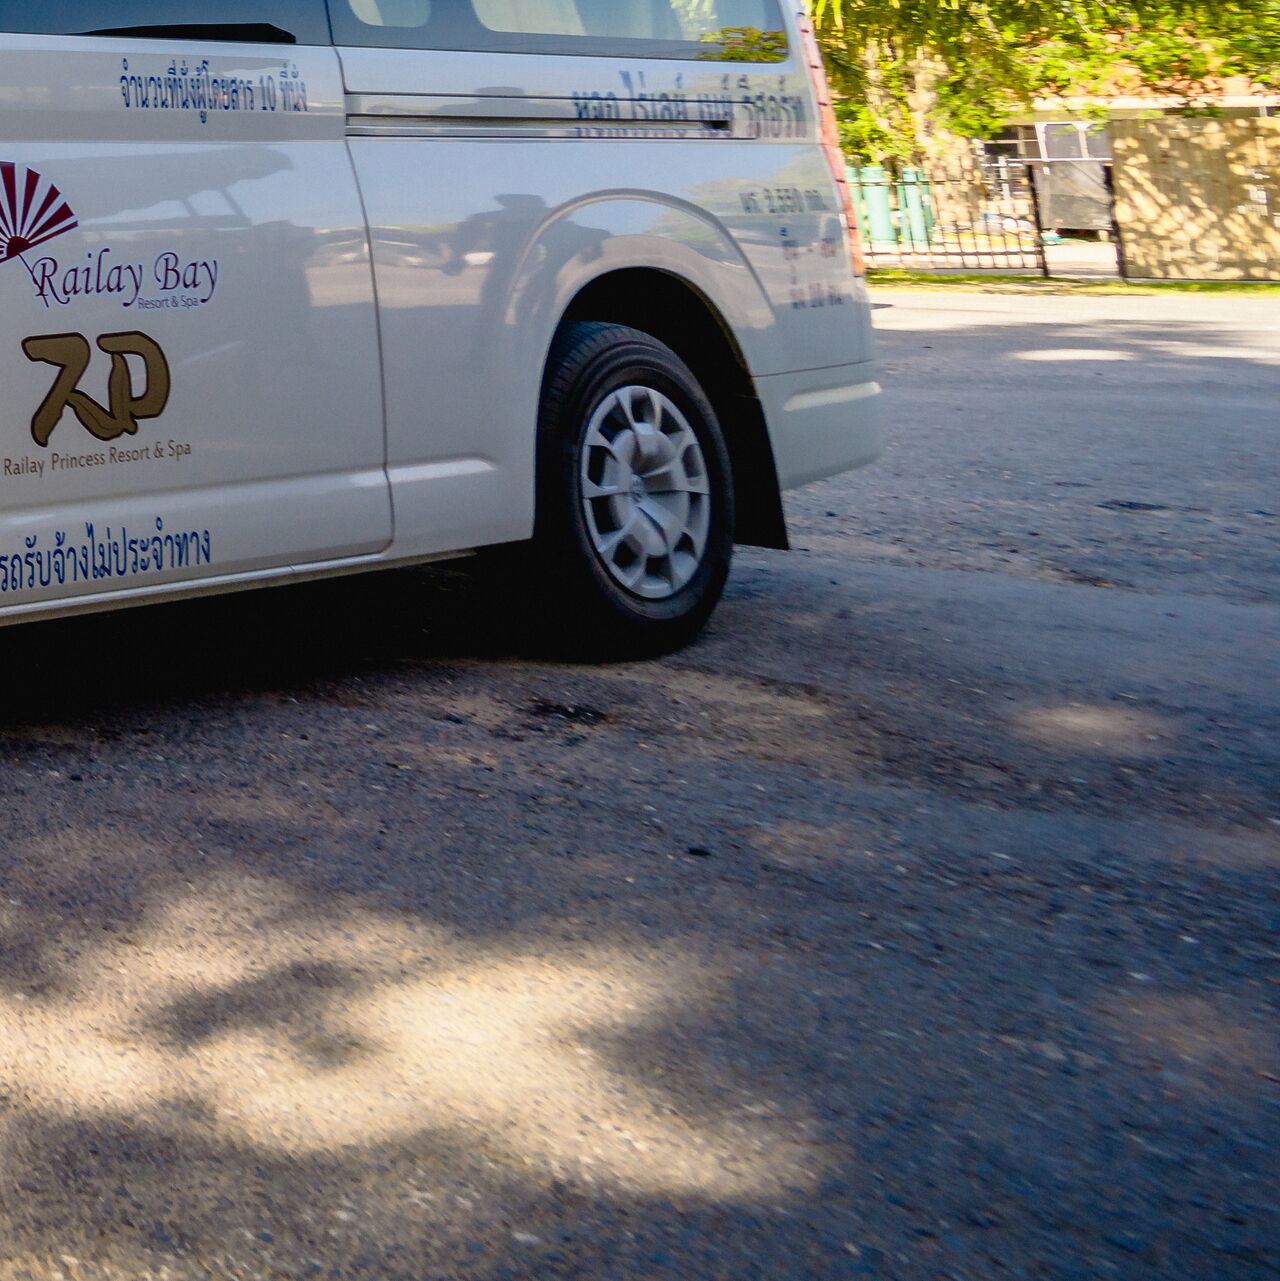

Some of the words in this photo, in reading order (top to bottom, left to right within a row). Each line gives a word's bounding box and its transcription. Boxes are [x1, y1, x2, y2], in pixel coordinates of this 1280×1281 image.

[119, 57, 256, 124] จำนวนที่นั่งผู้โดยสาร
[259, 74, 277, 111] 10
[279, 62, 309, 113] ที่นั่ง
[32, 248, 143, 307] Railay
[154, 252, 218, 304] Bay
[138, 297, 171, 309] Resort
[171, 296, 180, 308] &
[181, 295, 199, 309] Spa
[3, 456, 45, 479] Railay
[51, 452, 106, 470] Princess
[109, 446, 150, 464] Resort
[152, 441, 165, 459] &
[167, 439, 192, 462] Spa
